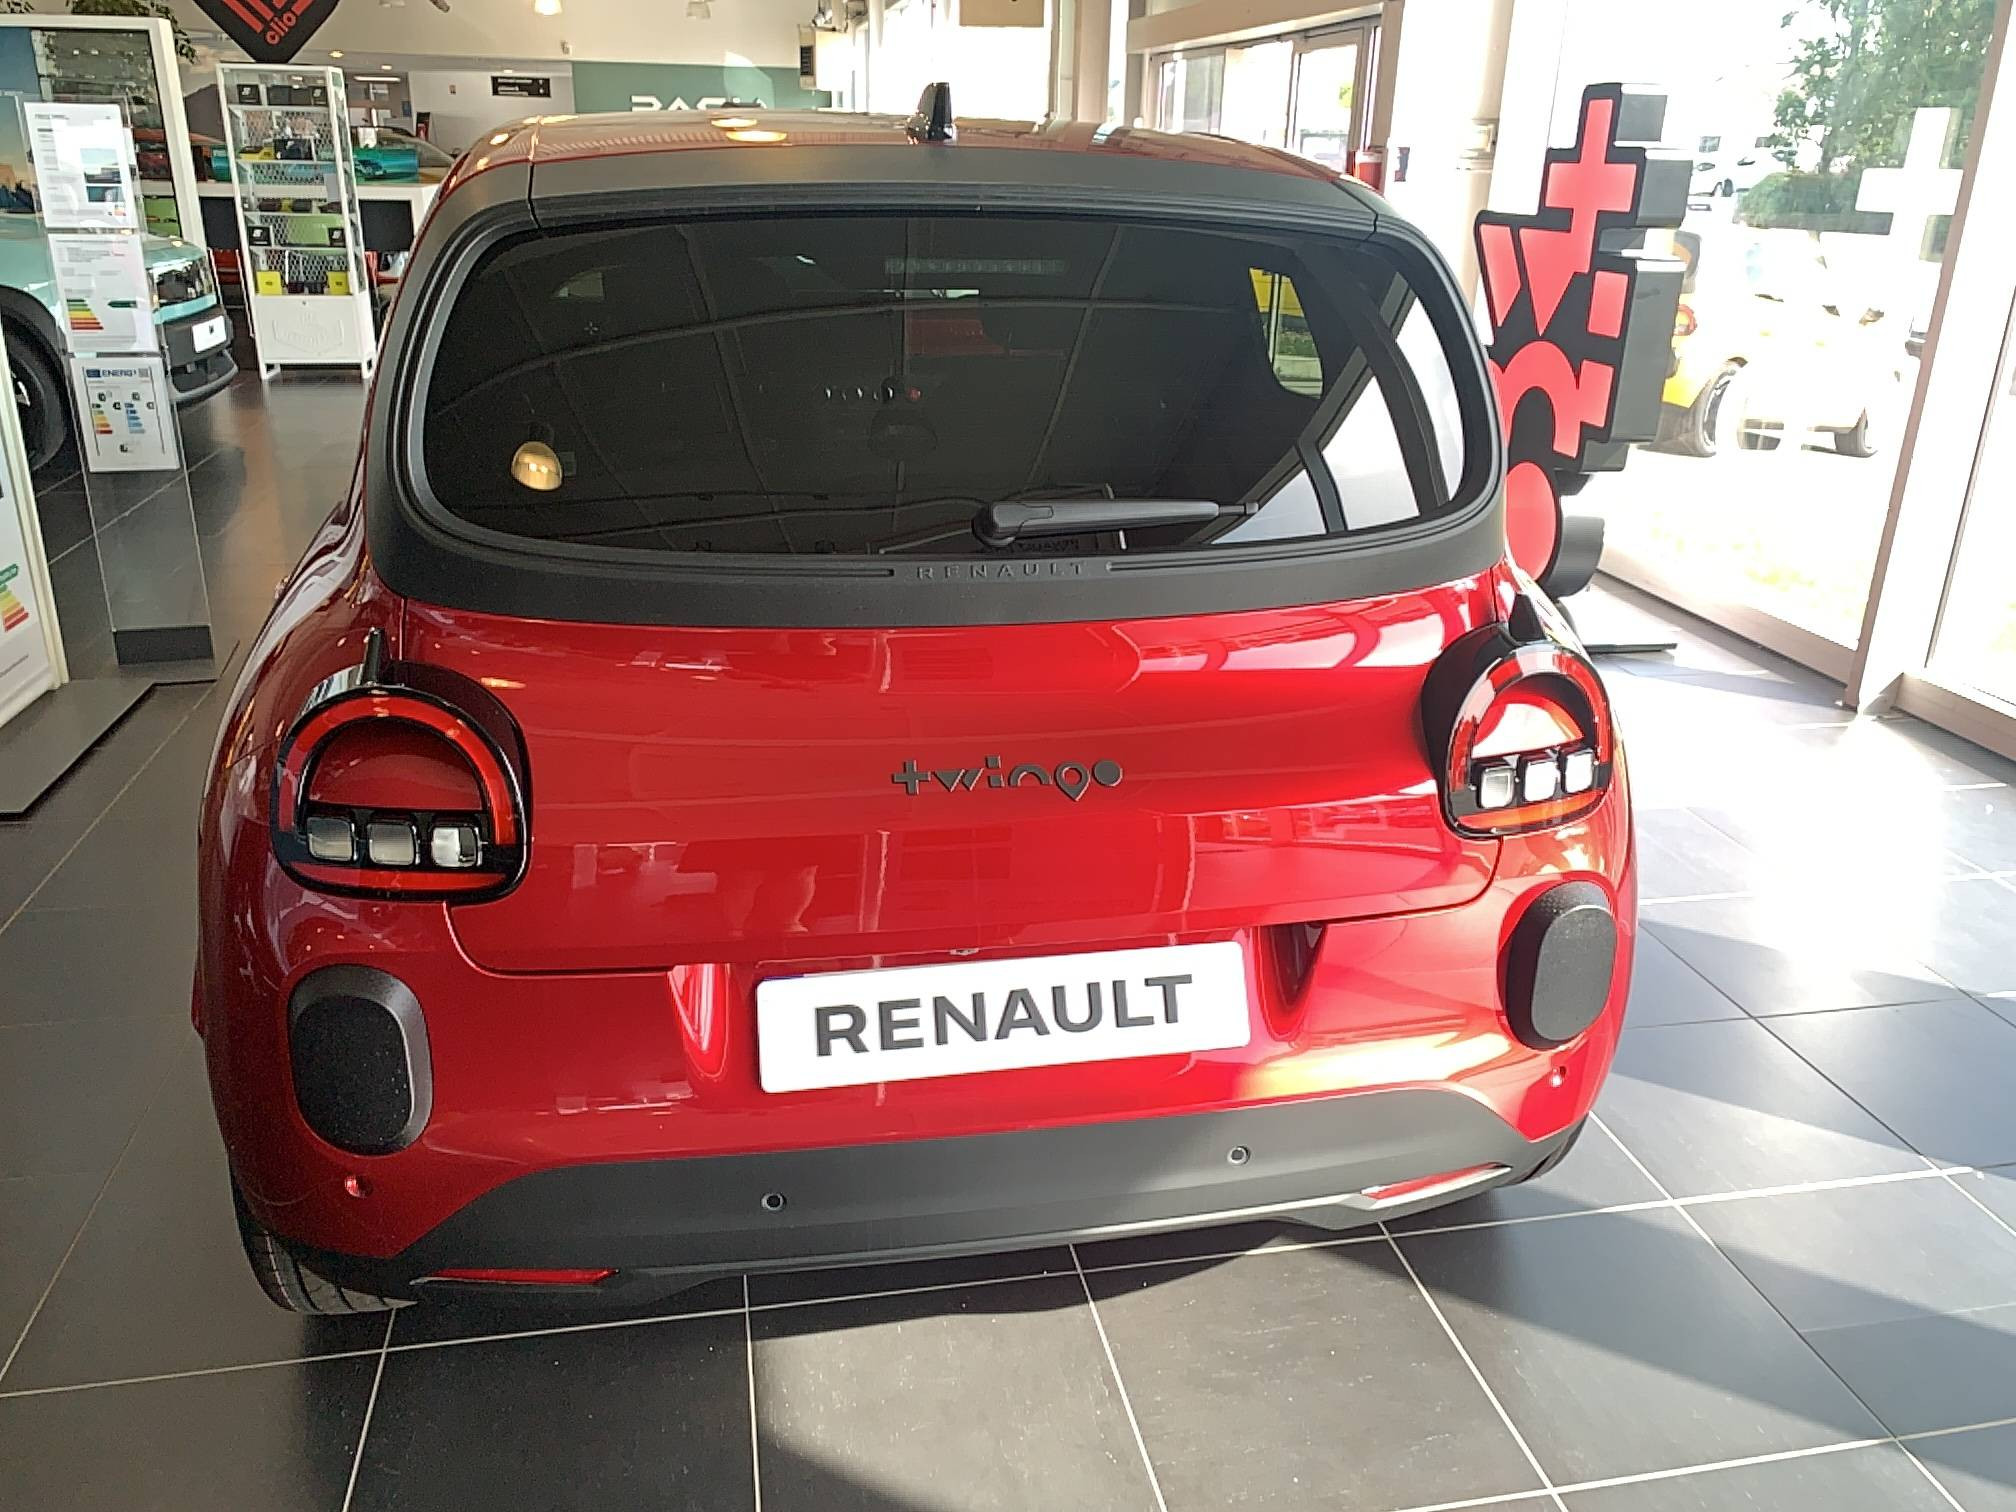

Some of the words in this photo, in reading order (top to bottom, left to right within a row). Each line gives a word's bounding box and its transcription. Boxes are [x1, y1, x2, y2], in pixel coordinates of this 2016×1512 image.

[265, 11, 297, 45] clio
[916, 562, 1085, 581] RENAULT
[892, 754, 1123, 801] twingo
[815, 973, 1193, 1057] RENAULT
